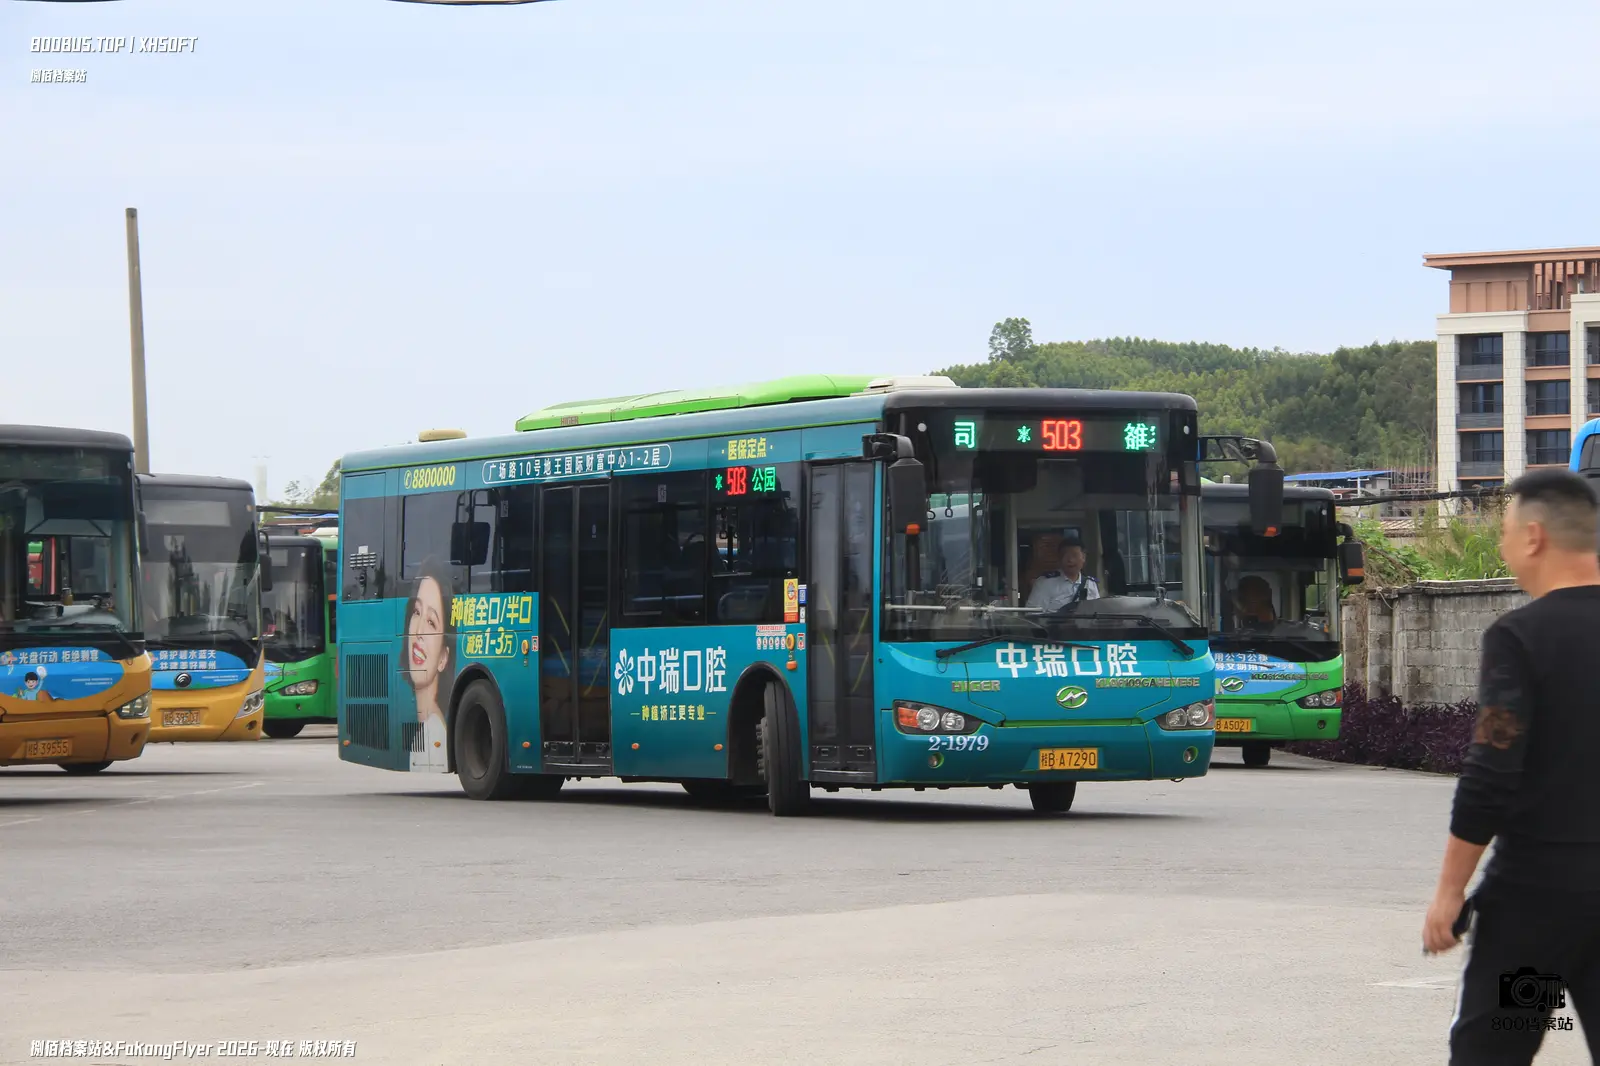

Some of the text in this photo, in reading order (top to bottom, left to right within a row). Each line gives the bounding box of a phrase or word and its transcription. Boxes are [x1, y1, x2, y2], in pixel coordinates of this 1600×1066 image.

[954, 420, 977, 449] 司
[1041, 420, 1083, 450] 503
[727, 437, 767, 461] 医保定点
[412, 465, 456, 490] 8800000
[488, 448, 661, 481] 广场路10号地王国际财富中心1-2层
[727, 467, 747, 496] 503
[752, 467, 776, 492] 公园
[450, 595, 532, 627] 种植全口/半口
[466, 626, 513, 655] 减免1-3万
[19, 651, 58, 664] 光盘行动
[160, 650, 216, 660] 保护碧水蓝天
[995, 643, 1142, 678] 中瑞口腔
[637, 646, 727, 695] 中瑞口腔
[952, 680, 1000, 692] HIGER
[642, 704, 704, 721] 种植矫正更专业
[928, 735, 989, 751] 2-1979
